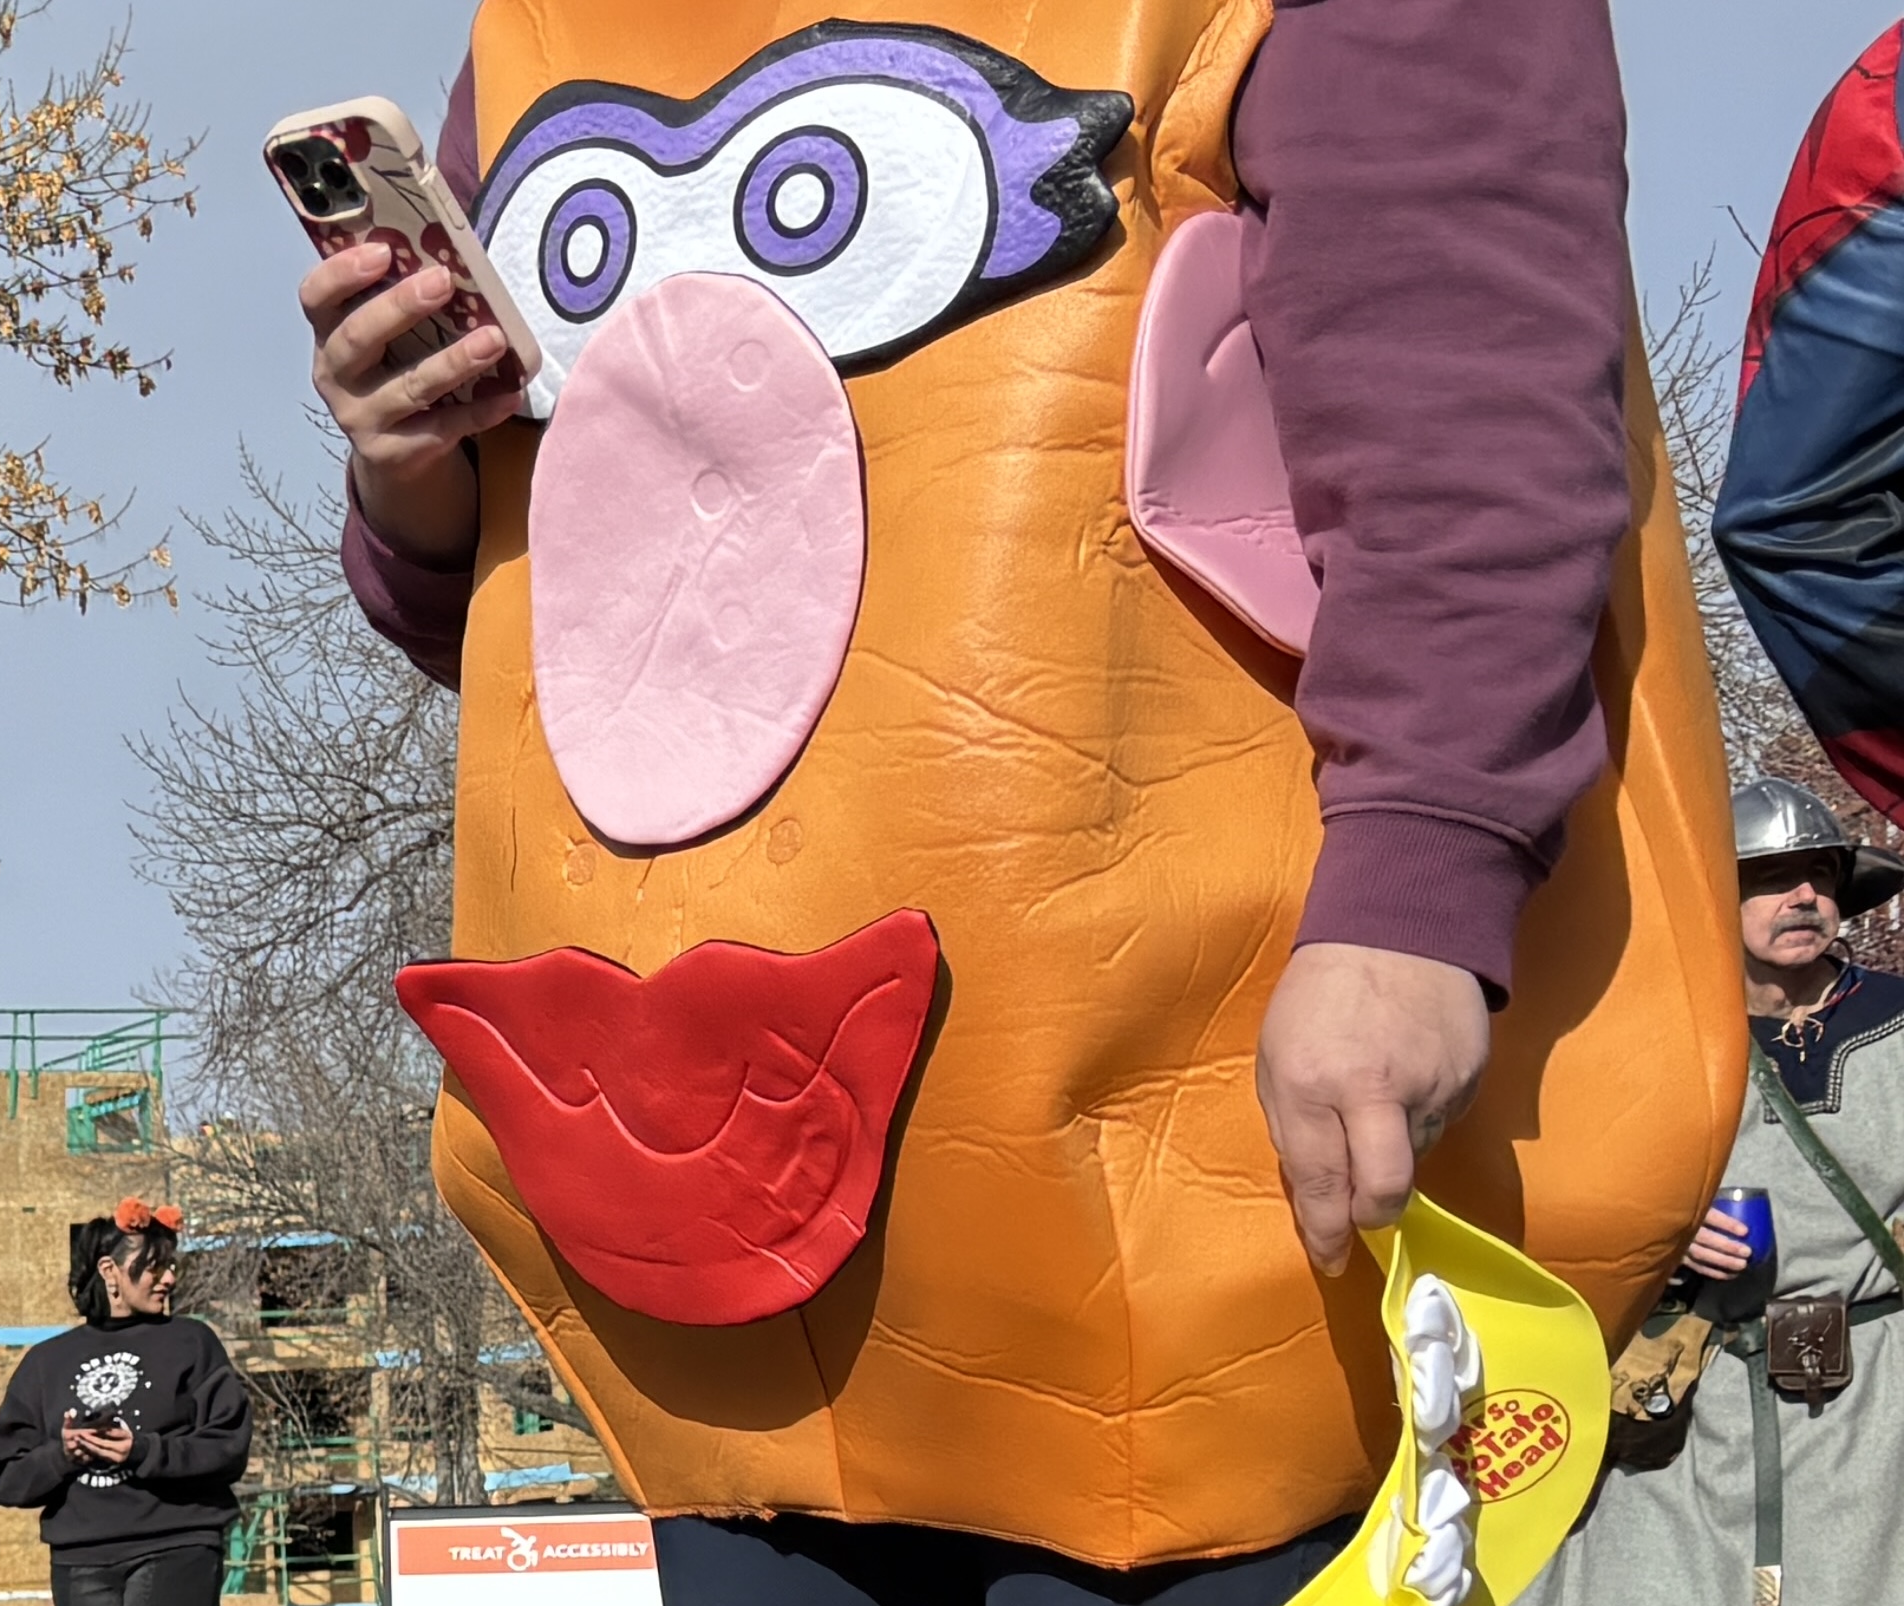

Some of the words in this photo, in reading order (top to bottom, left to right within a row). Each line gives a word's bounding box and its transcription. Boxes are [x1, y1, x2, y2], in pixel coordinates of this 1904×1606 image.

[1473, 1423, 1564, 1498] Head
[448, 1546, 506, 1561] TREAT
[542, 1542, 649, 1559] ACCESSIBLY
